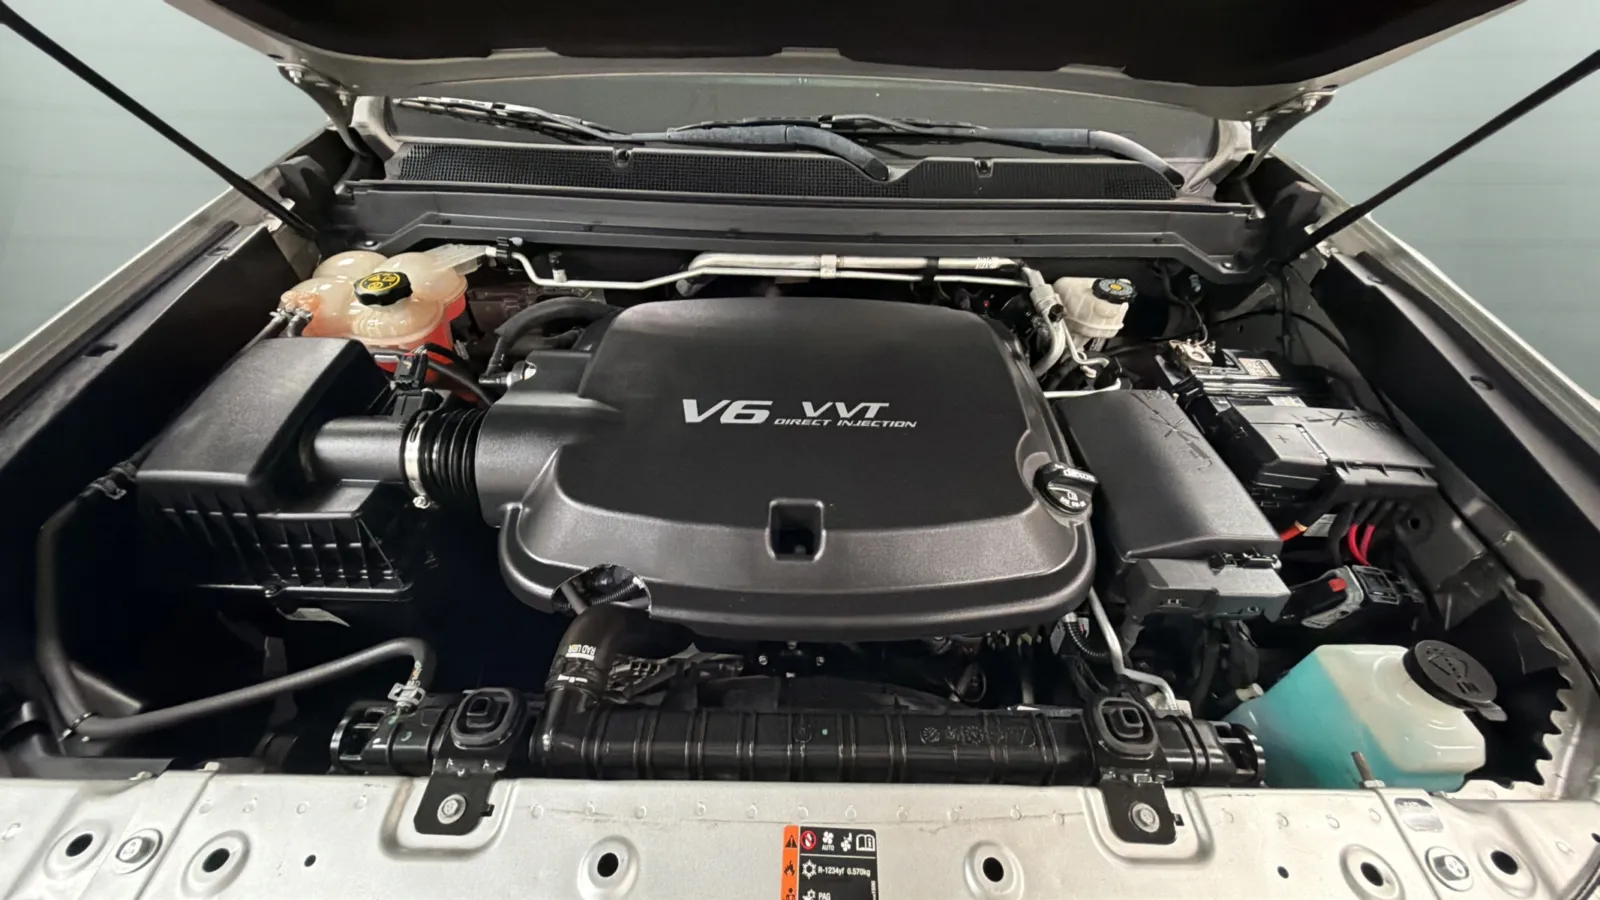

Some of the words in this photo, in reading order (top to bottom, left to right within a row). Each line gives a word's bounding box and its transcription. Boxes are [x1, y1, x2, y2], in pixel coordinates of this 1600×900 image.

[683, 399, 773, 424] V6
[801, 401, 890, 418] VVT
[774, 418, 832, 426] DIRECT
[836, 419, 917, 428] INJECTION
[581, 644, 596, 655] RAD
[818, 866, 844, 876] R-1234yf
[847, 868, 871, 877] 0.570kg
[818, 892, 831, 900] PAG
